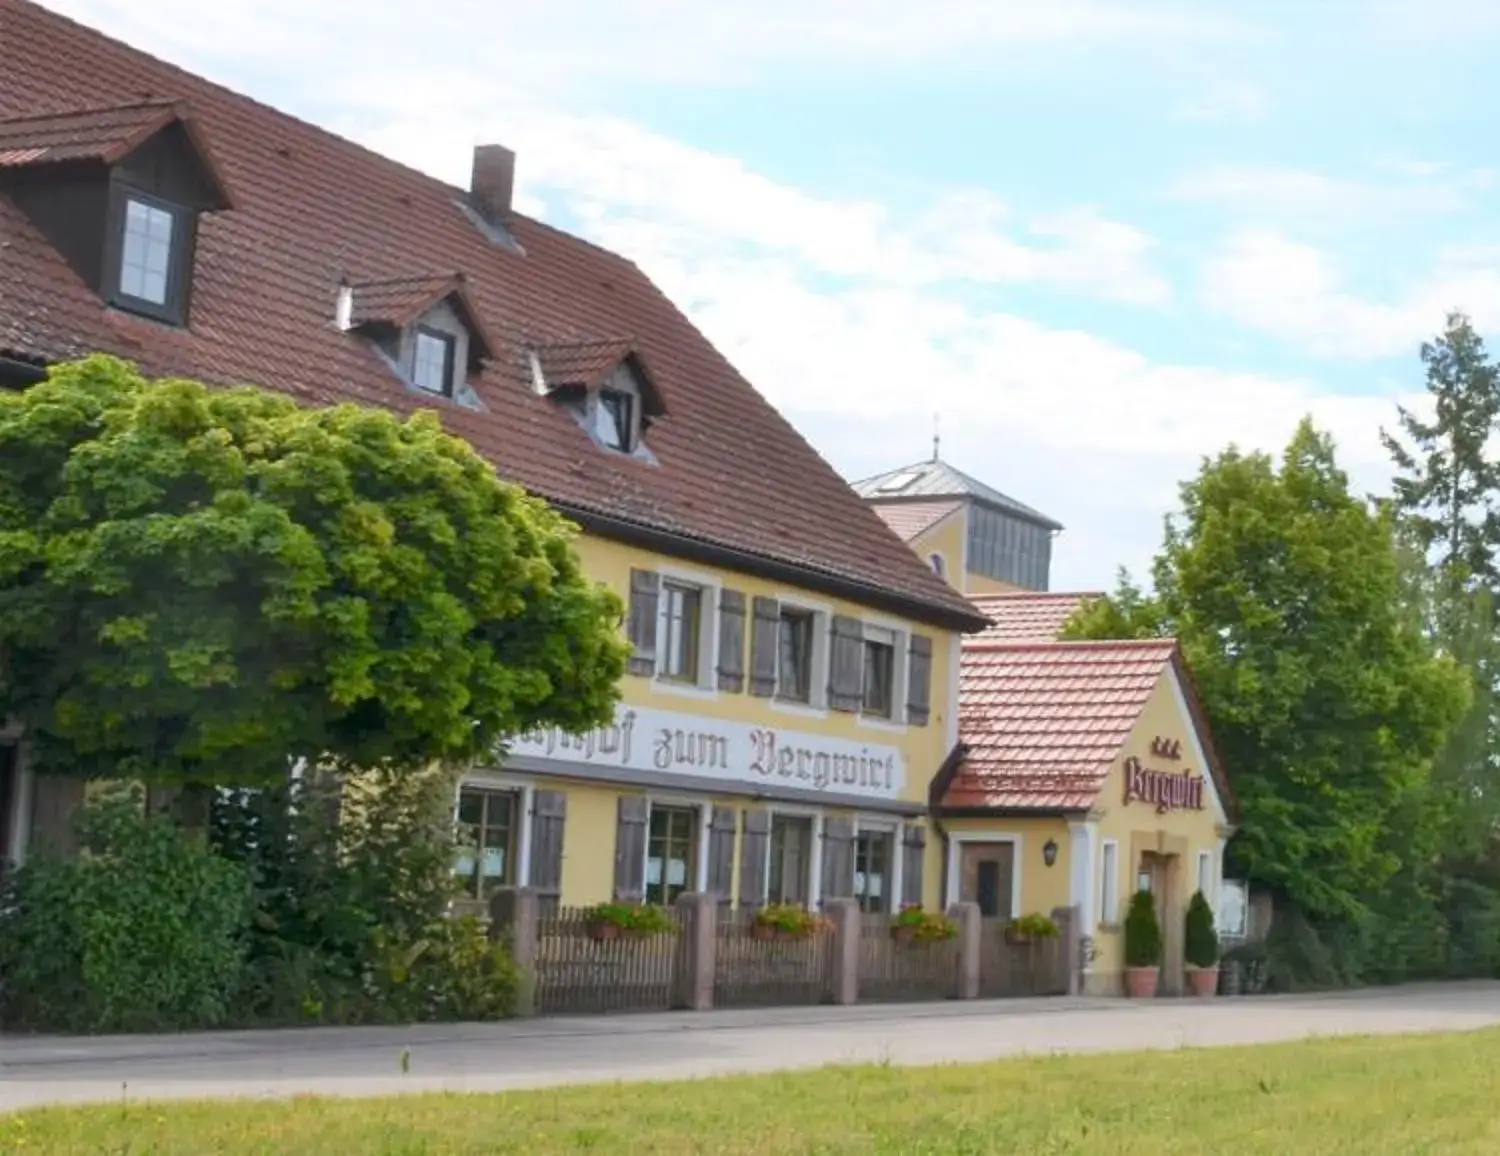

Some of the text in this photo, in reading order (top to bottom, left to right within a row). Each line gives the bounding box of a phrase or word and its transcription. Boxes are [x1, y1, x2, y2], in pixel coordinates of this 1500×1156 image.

[653, 728, 727, 769] zum
[749, 729, 894, 789] Bergwirt
[1122, 756, 1205, 814] Bergwirt
